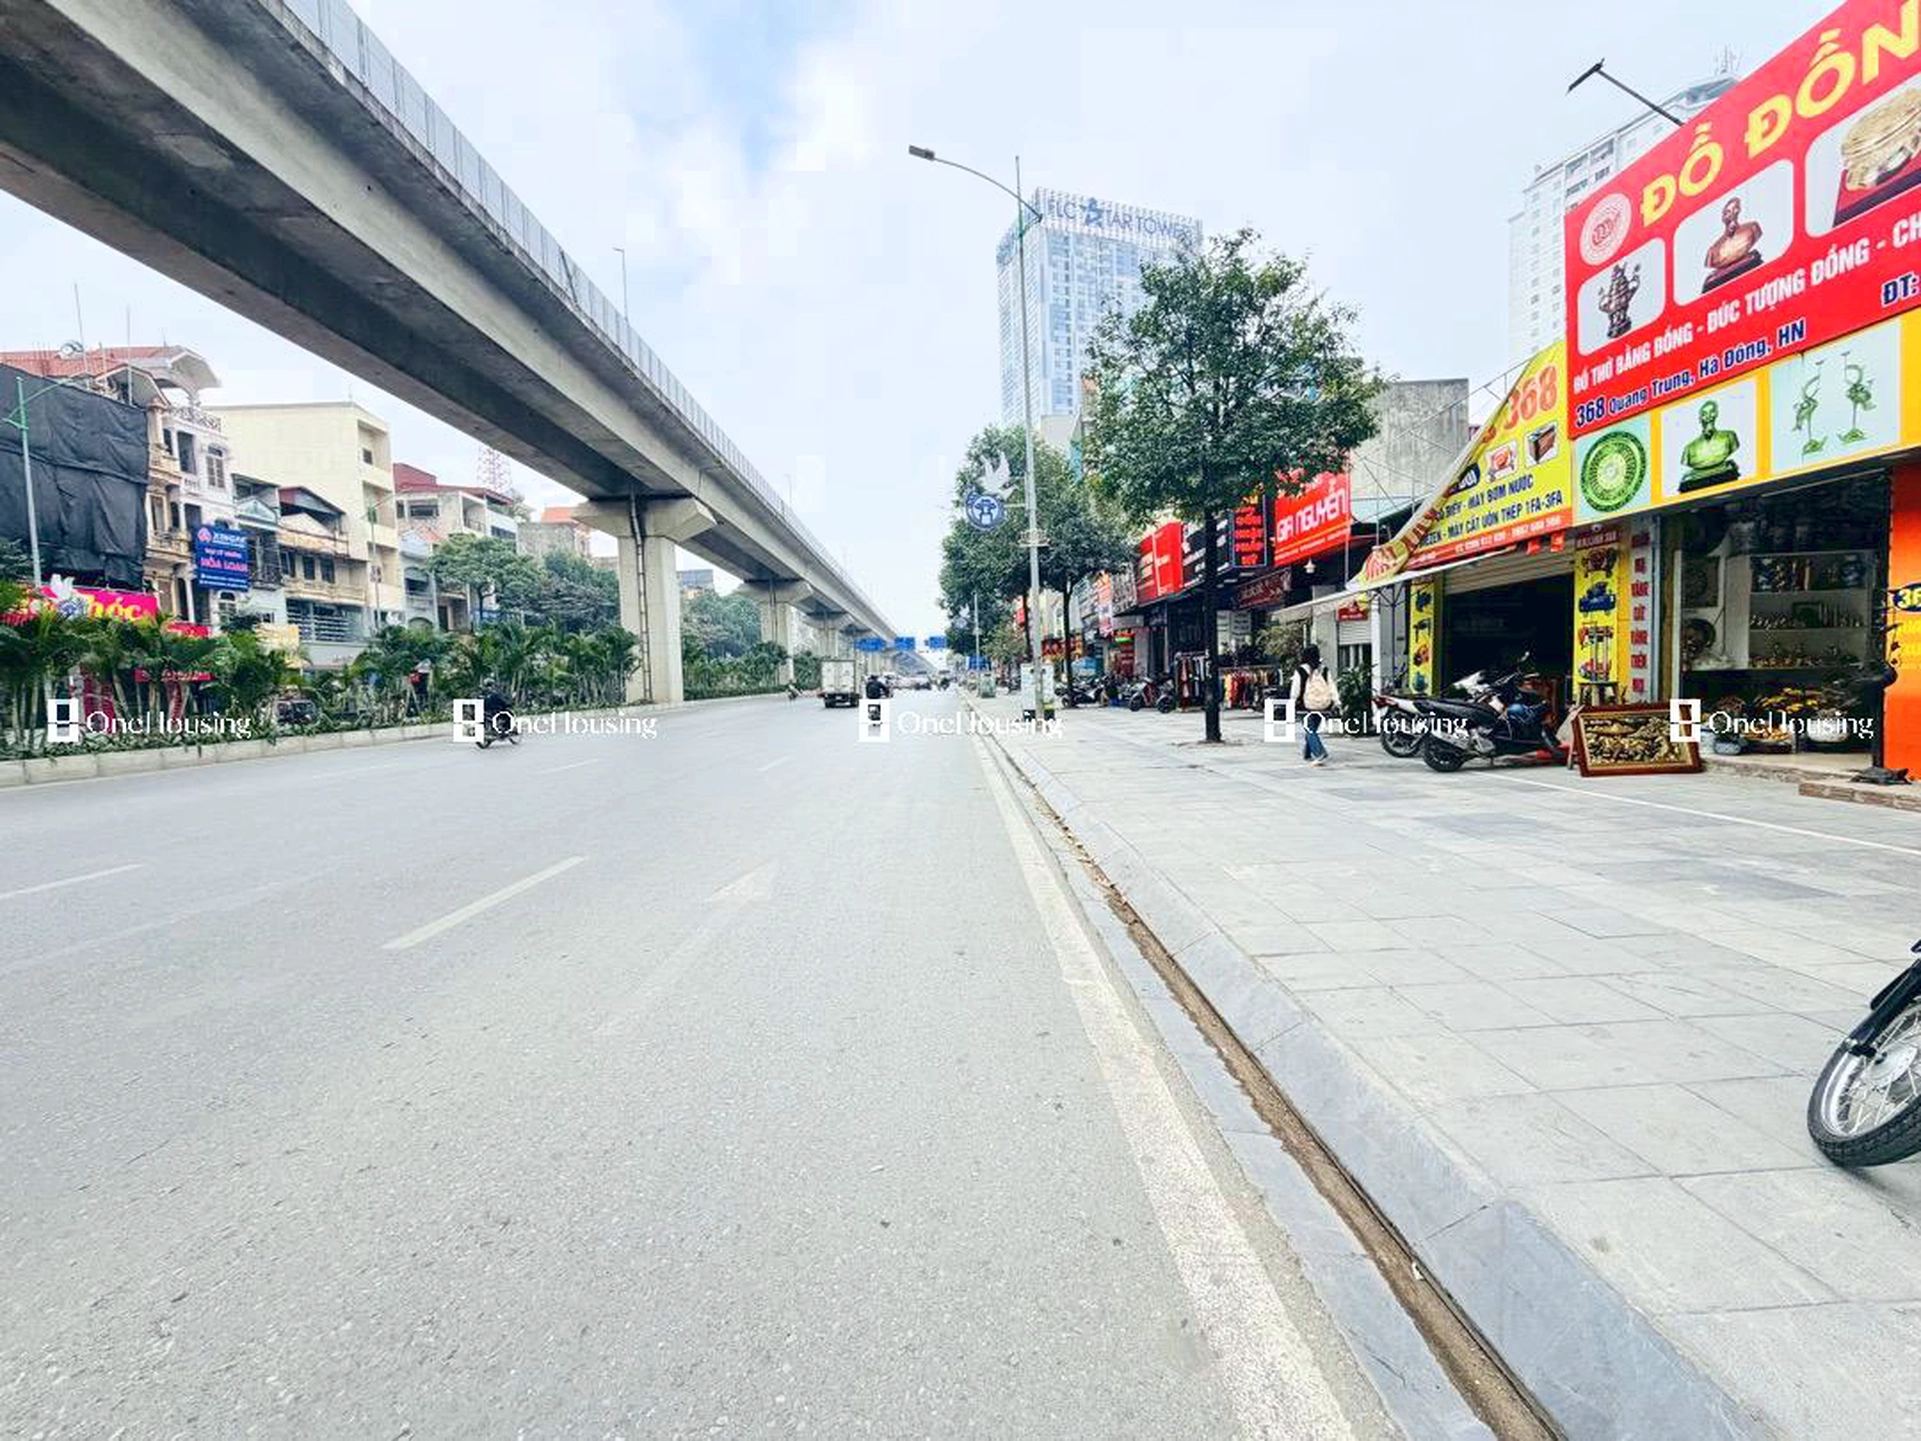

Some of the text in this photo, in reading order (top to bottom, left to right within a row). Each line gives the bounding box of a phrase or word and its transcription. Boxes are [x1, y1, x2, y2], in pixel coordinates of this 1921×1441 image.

[1640, 121, 1724, 228] ĐỒ
[1591, 355, 1614, 387] THỜ
[1615, 341, 1652, 375] BẰNG
[1653, 320, 1694, 358] ĐỒNG
[1707, 299, 1741, 334] ĐÚC
[1744, 268, 1806, 316] TƯỢNG
[1810, 237, 1870, 286] ĐỒNG
[1882, 272, 1919, 307] ĐT:
[1576, 395, 1605, 428] 368
[1609, 388, 1648, 414] Quang
[1699, 354, 1719, 378] Hà
[1778, 317, 1805, 348] HN
